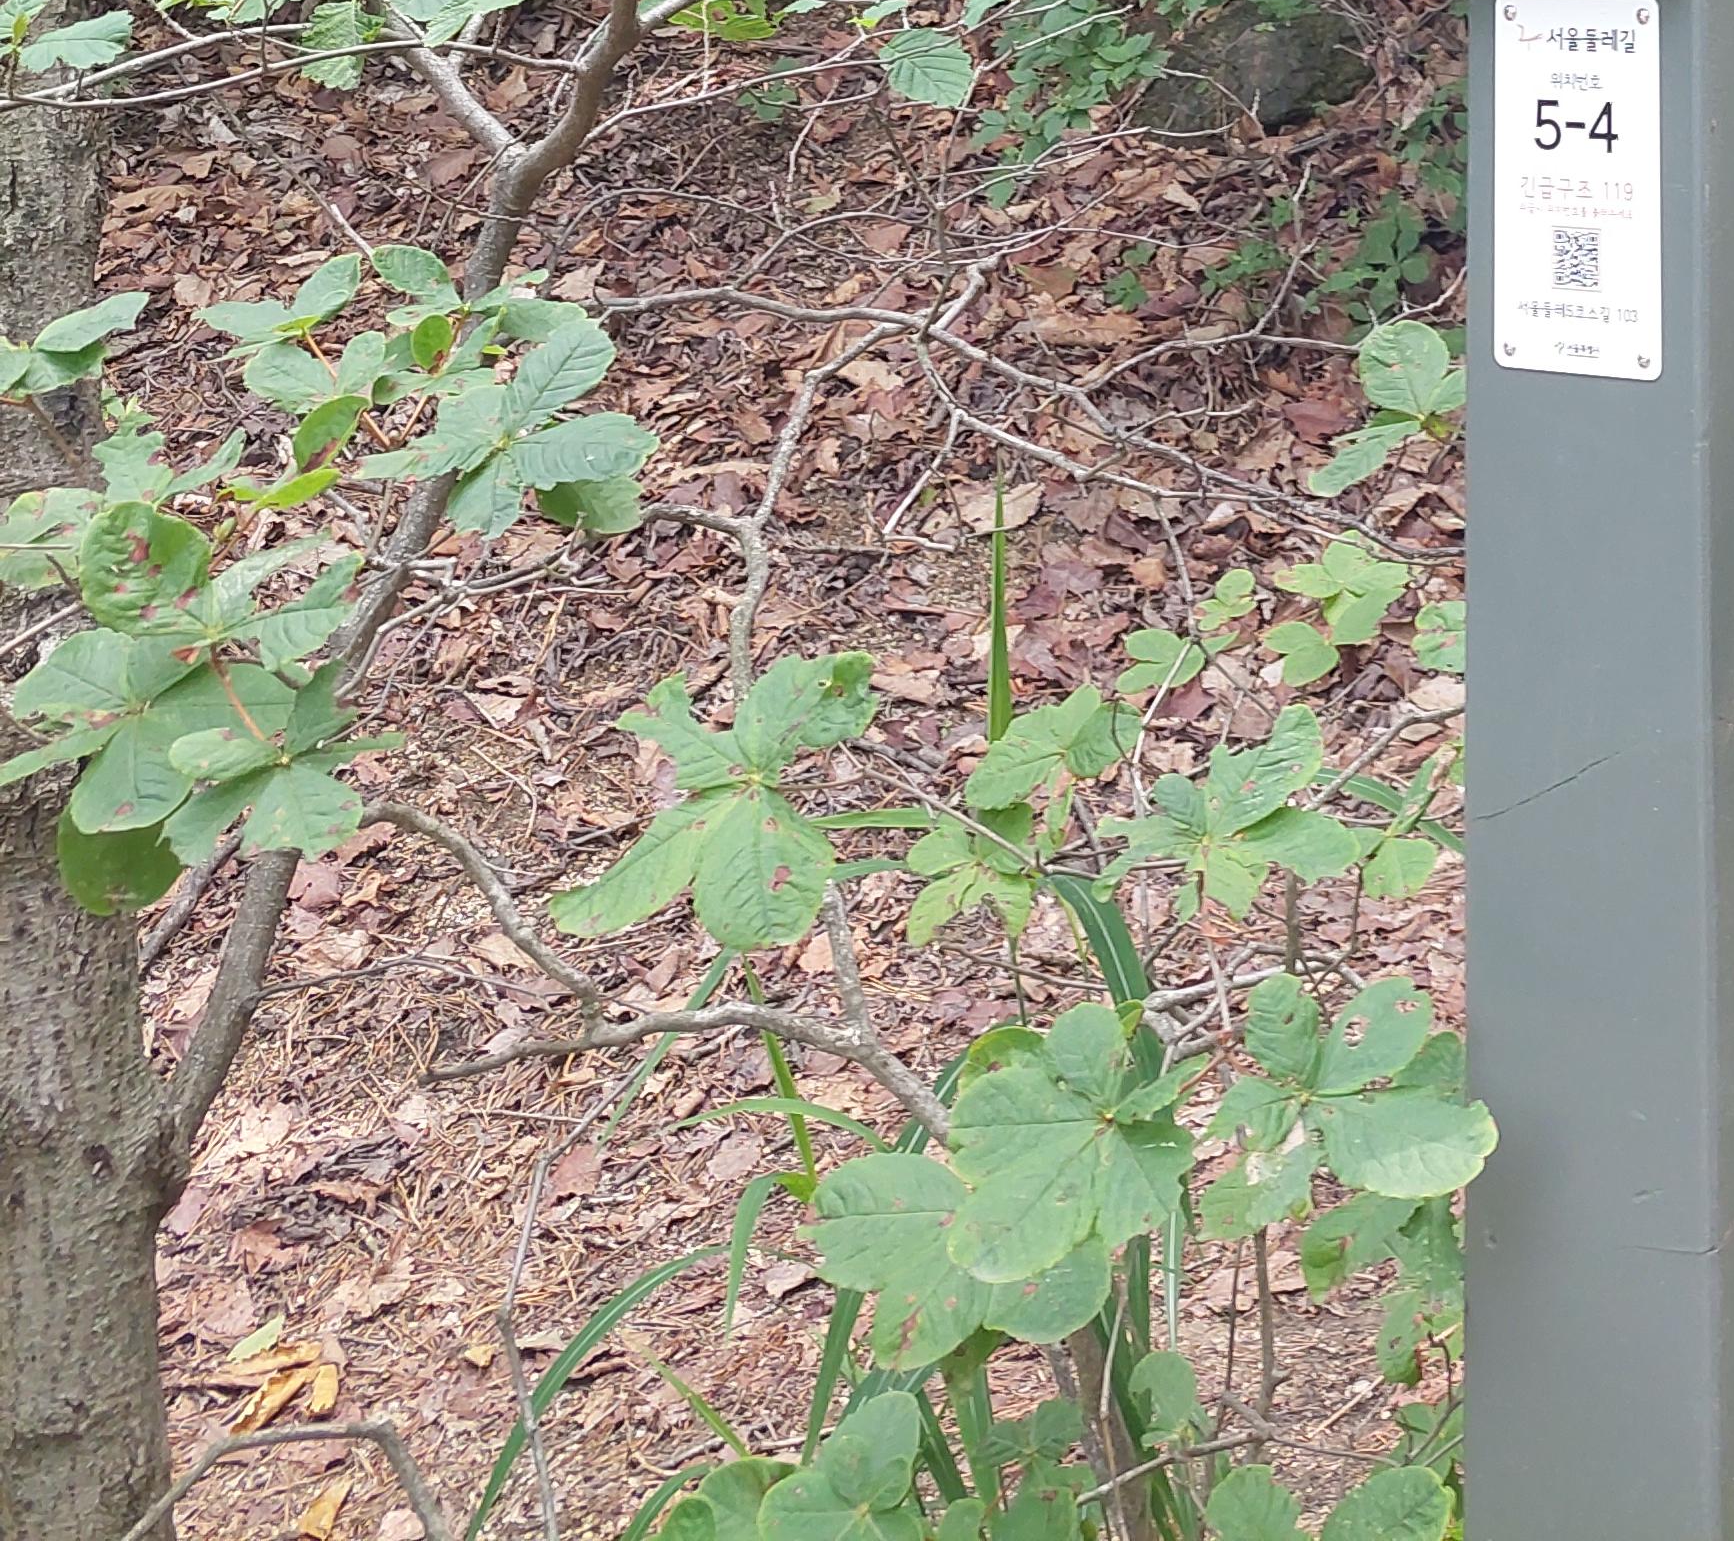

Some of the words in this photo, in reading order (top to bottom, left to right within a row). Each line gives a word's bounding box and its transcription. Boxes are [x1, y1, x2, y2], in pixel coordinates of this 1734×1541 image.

[1546, 27, 1636, 54] 서울둘레길
[1534, 99, 1619, 153] 5-4
[1520, 175, 1593, 200] 긴급구조
[1604, 181, 1633, 202] 119
